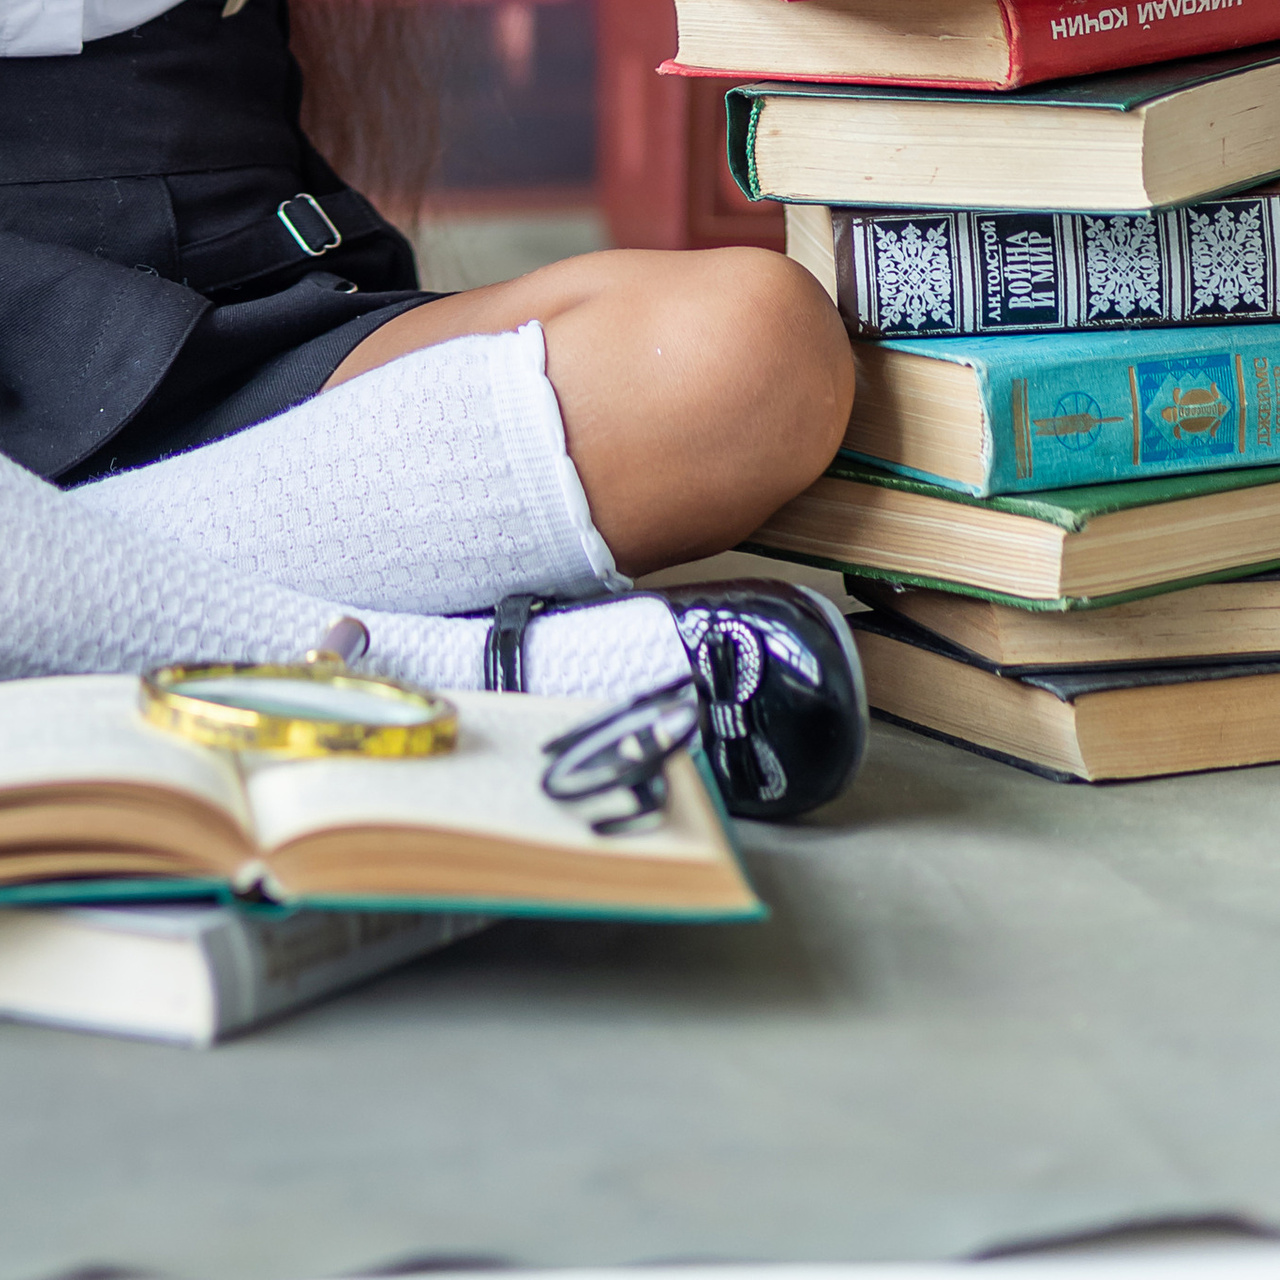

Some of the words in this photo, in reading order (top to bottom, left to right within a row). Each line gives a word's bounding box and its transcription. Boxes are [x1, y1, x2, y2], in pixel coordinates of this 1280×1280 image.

[1051, 6, 1128, 40] КОЧИН
[1003, 230, 1032, 309] ВОЙНА
[1029, 231, 1055, 284] МИР
[1030, 290, 1055, 308] И
[1253, 356, 1272, 447] ДЖЕЙМС
